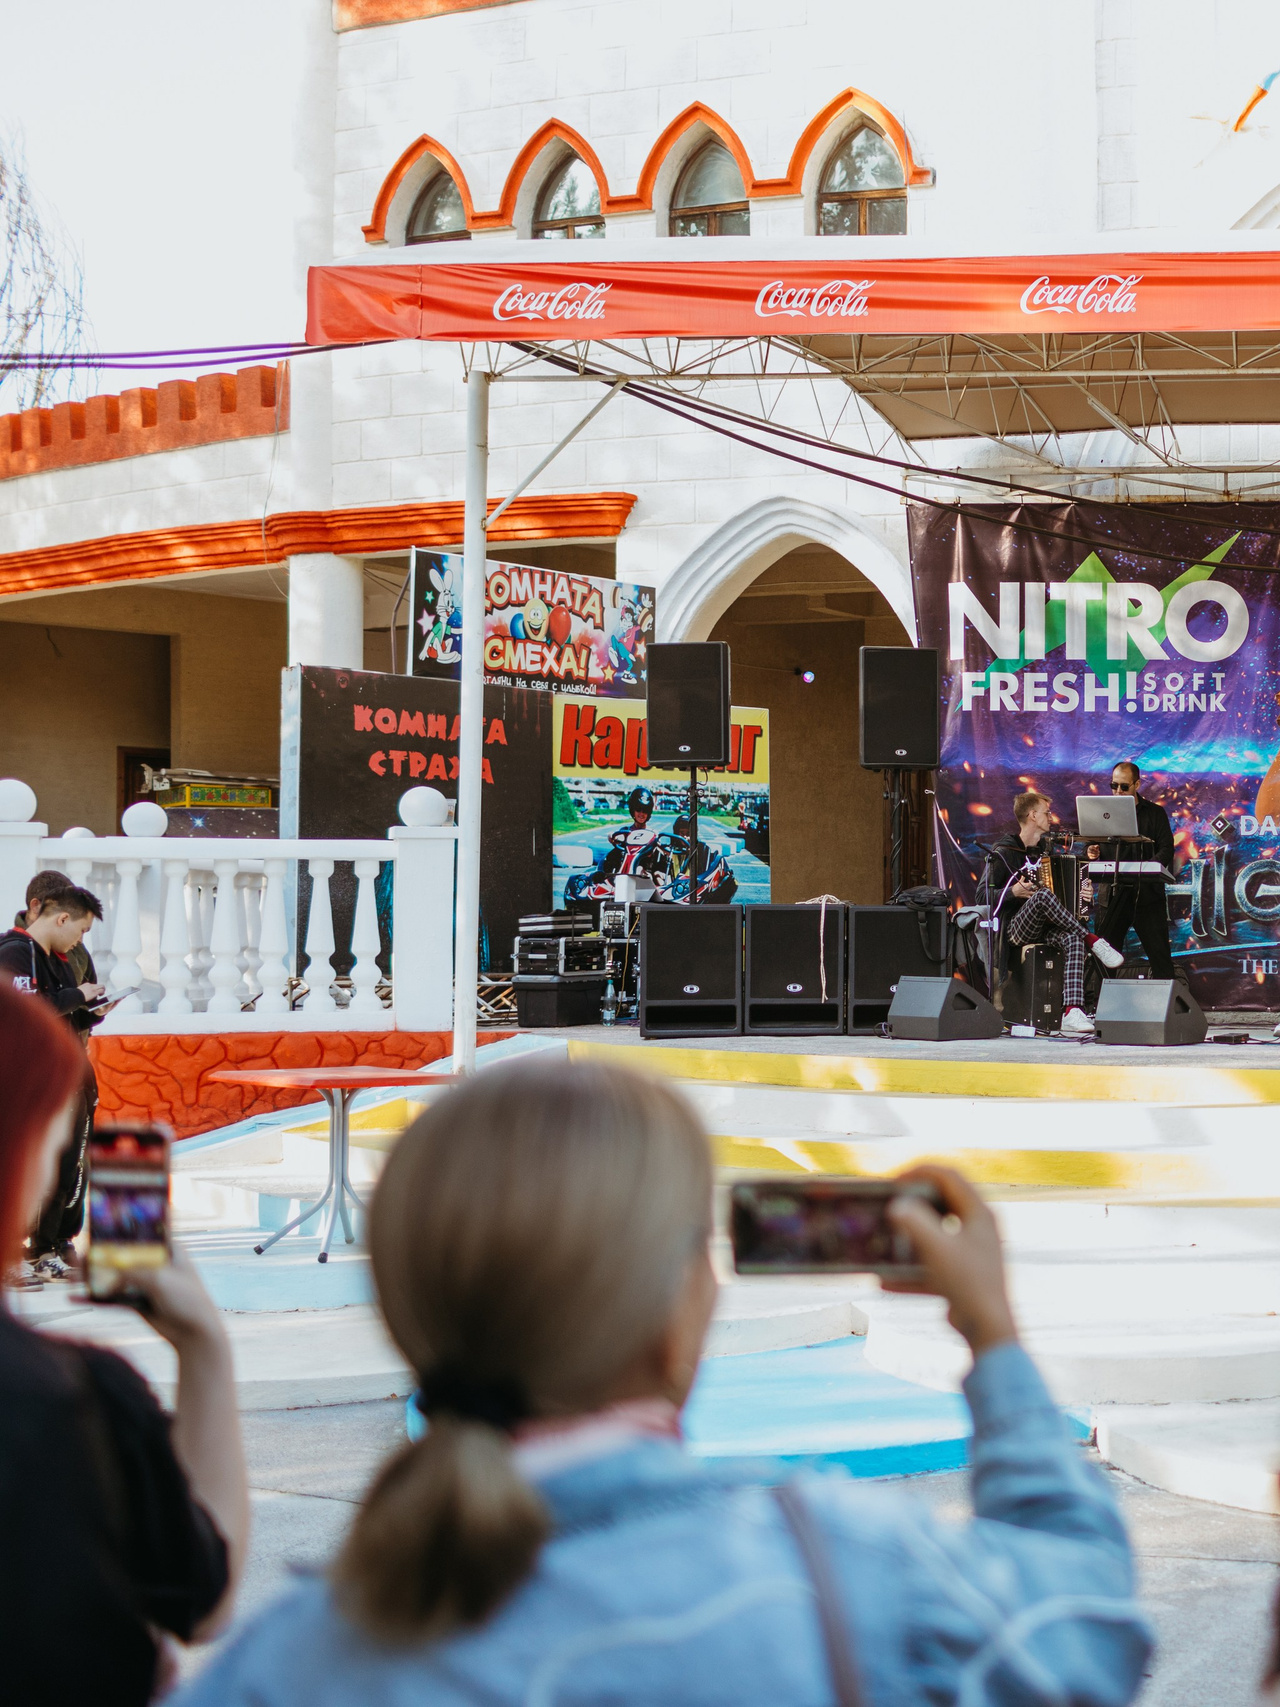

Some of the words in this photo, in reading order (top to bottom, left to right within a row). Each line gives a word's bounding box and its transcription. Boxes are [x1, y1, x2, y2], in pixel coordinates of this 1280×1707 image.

[493, 283, 612, 321] Coca-Cola
[755, 280, 875, 317] Coca-Cola
[1020, 275, 1143, 315] Coca-Cola
[485, 568, 604, 630] ОМНАТА
[948, 579, 1250, 663] NITRO
[485, 635, 591, 680] СМЕХА!
[961, 672, 1138, 713] FRESH!
[1143, 672, 1226, 692] SOFT
[1143, 694, 1227, 712] DRINK
[560, 704, 763, 775] Карг
[1238, 959, 1279, 975] THE
